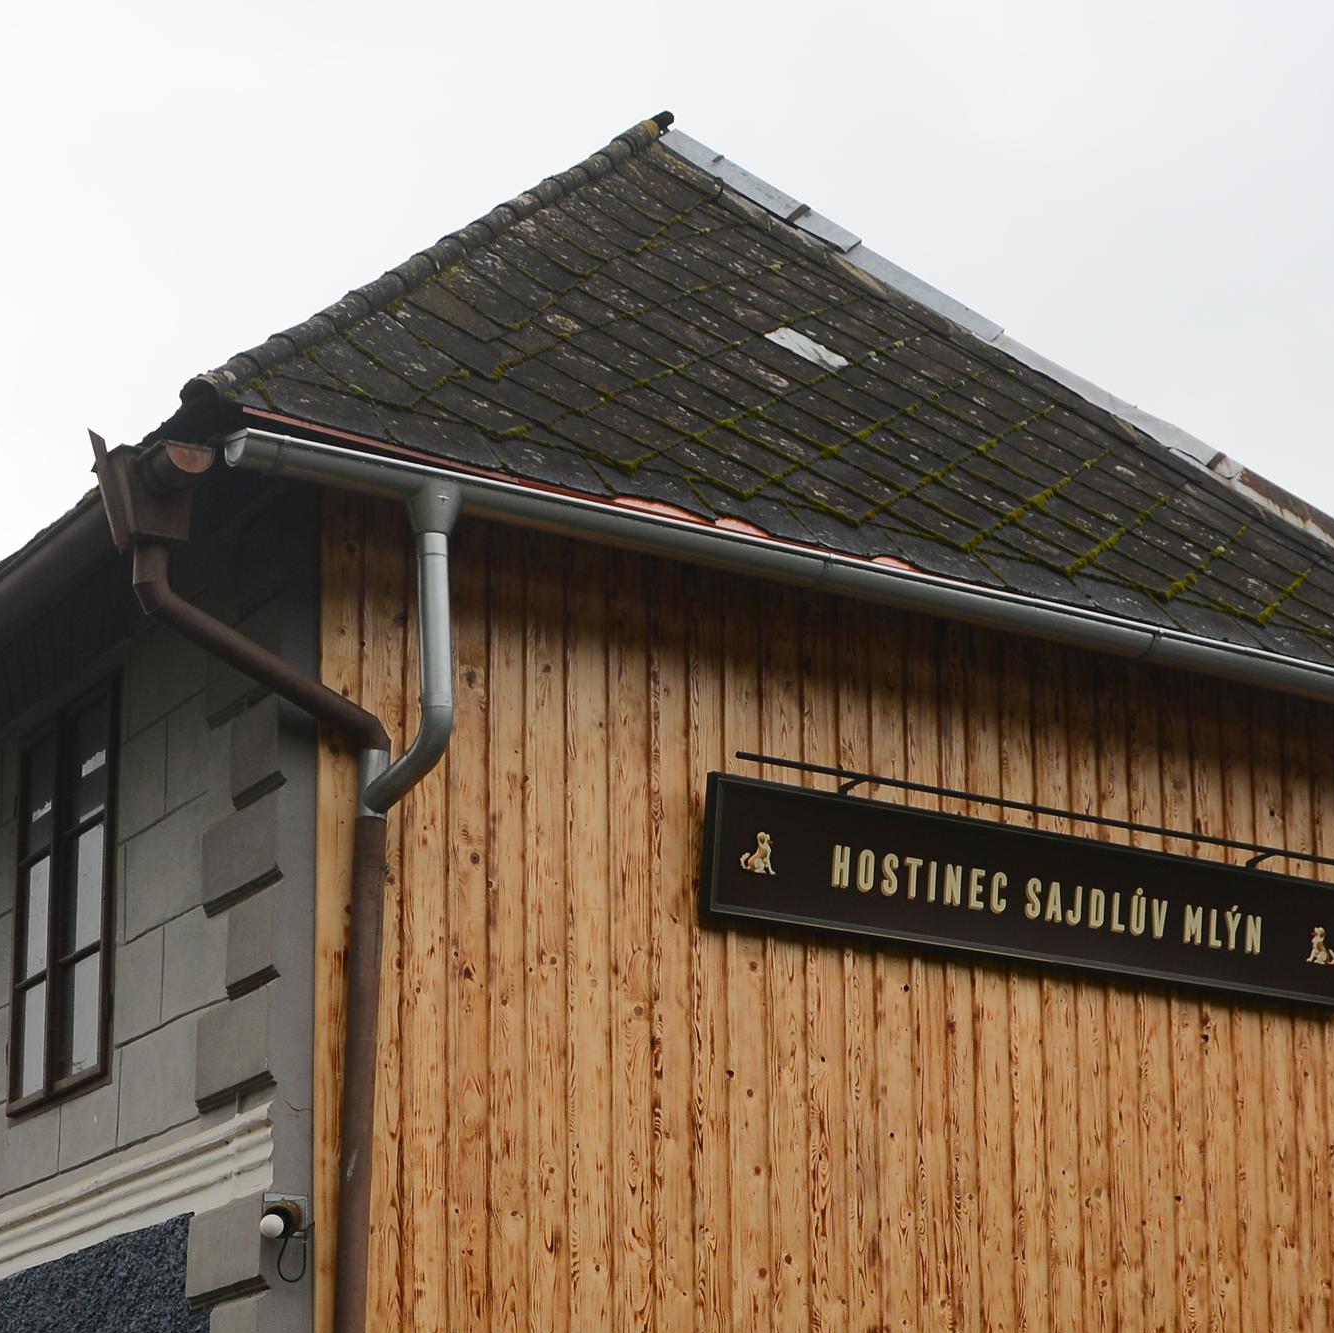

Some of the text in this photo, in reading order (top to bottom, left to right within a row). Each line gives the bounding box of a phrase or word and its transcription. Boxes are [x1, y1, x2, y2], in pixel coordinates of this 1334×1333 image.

[831, 844, 1263, 955] HOSTINEC SAJDLŮV MLÝN
